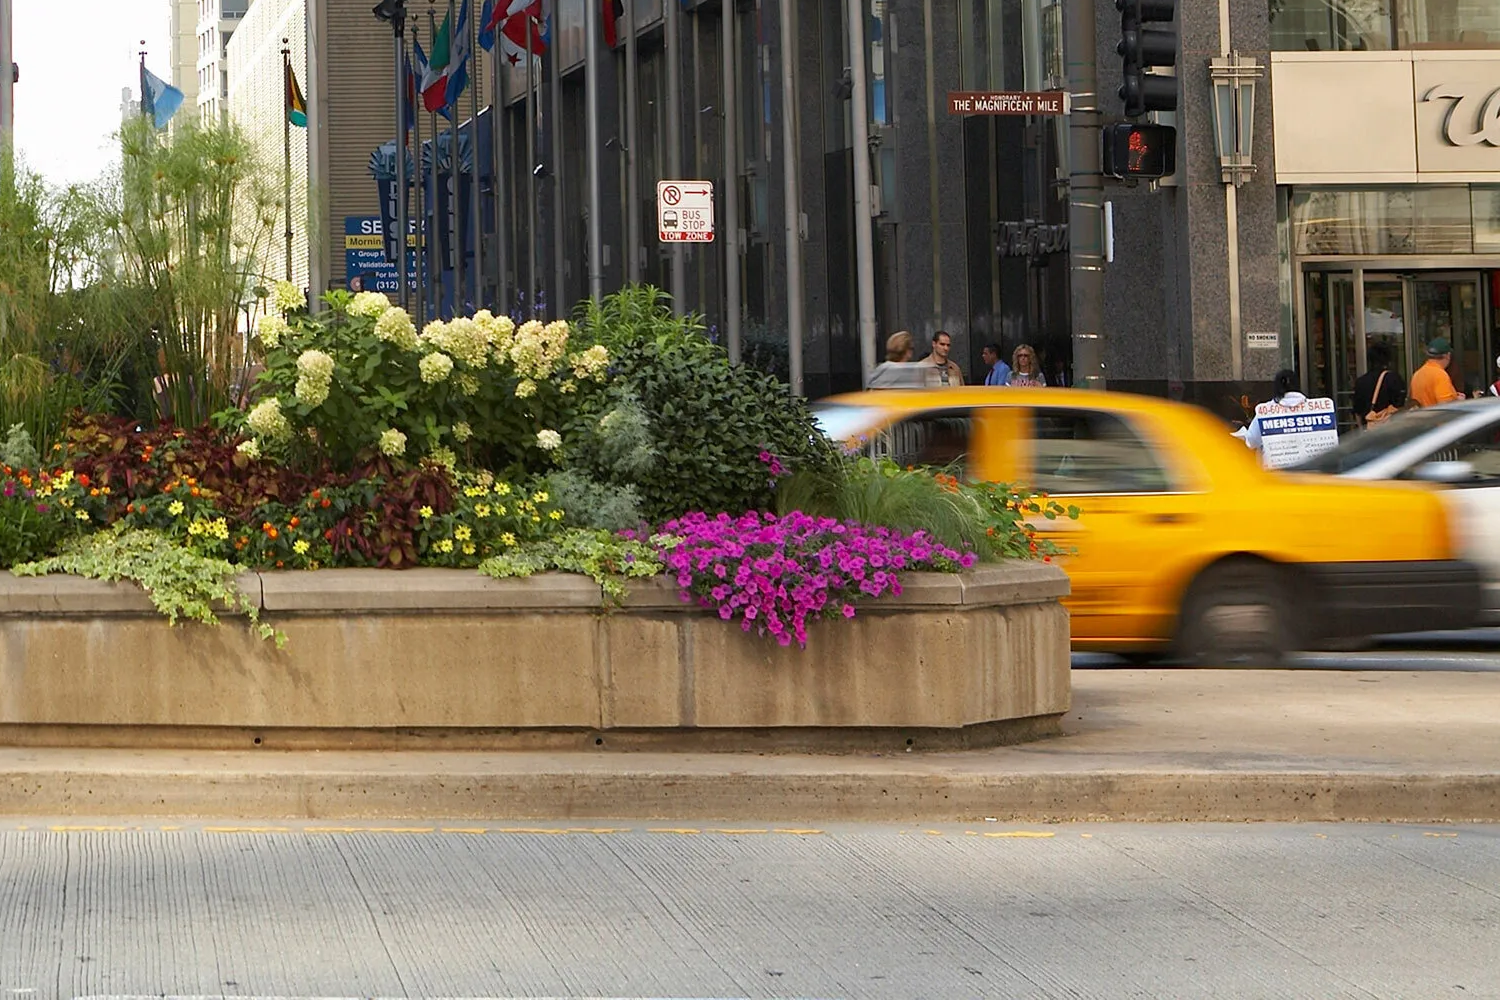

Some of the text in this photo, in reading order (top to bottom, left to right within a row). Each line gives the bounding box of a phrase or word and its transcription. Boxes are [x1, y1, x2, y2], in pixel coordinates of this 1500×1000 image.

[954, 100, 1058, 112] THE MAGNIFICENT MILE
[682, 210, 701, 220] BUS
[682, 220, 706, 230] STOP
[664, 232, 709, 240] TOW ZONE
[349, 237, 384, 246] Mornin
[358, 250, 380, 259] Group
[376, 281, 399, 291] (312)
[1258, 404, 1288, 416] 40-60%
[1308, 399, 1331, 411] SALE
[1262, 415, 1332, 430] MENS SUITS
